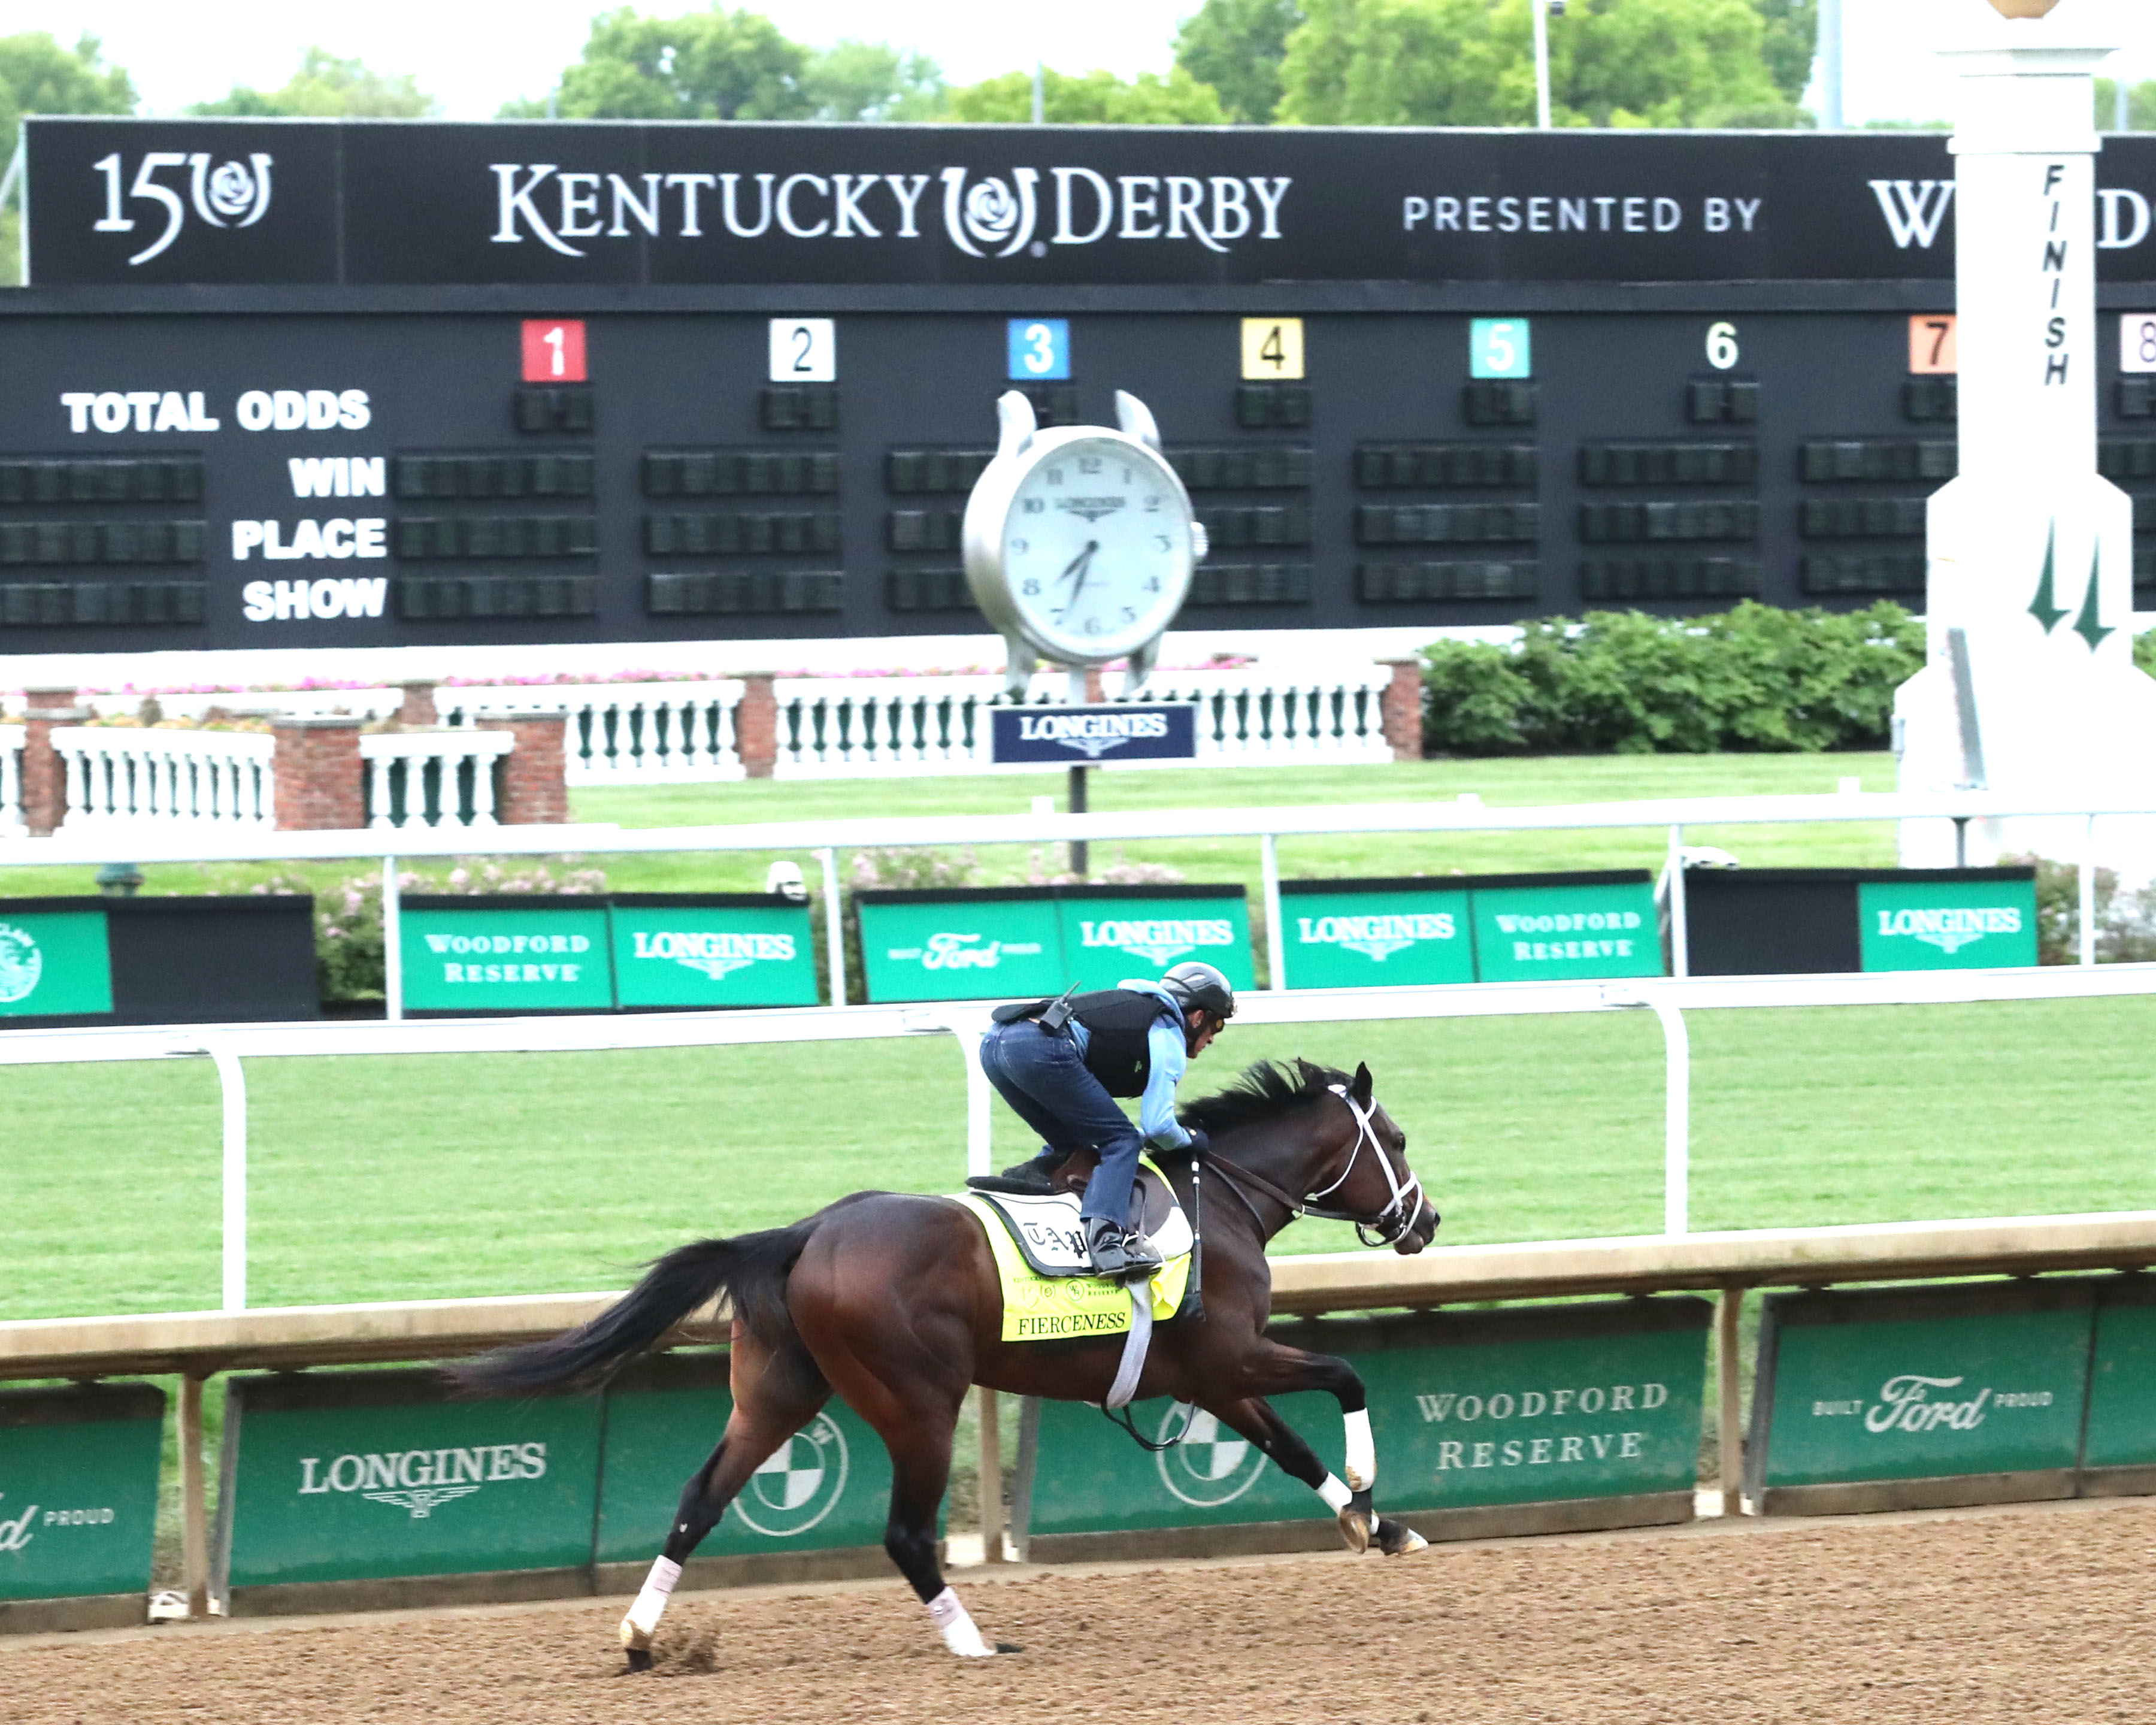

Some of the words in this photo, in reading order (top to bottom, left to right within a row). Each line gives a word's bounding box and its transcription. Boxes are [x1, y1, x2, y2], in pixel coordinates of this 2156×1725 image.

[490, 164, 929, 256] KENTUCKY
[1051, 167, 1291, 252] DERBY
[1405, 197, 1680, 231] PRESENTED
[1706, 198, 1760, 232] BY
[2044, 165, 2067, 384] FINISH
[543, 328, 565, 376] 1
[794, 327, 811, 371] 2
[1025, 324, 1053, 373] 3
[1261, 327, 1284, 368] 4
[1486, 324, 1515, 371] 5
[1706, 322, 1738, 369] 6
[1926, 321, 1949, 364] 7
[2142, 322, 2156, 362] 8
[61, 392, 219, 432] TOTAL
[237, 389, 370, 431] ODDS
[289, 457, 385, 497] WIN
[232, 518, 386, 560] PLACE
[243, 577, 387, 621] SHOW
[1021, 713, 1168, 740] LONGINES
[1081, 920, 1234, 946] LONGINES
[1298, 913, 1455, 943] LONGINES
[1496, 912, 1640, 932] WOODFORD
[1879, 907, 2021, 936] LONGINES
[425, 934, 589, 953] WOODFORD
[634, 932, 795, 961] LONGINES
[922, 933, 1001, 970] Ford
[1514, 940, 1632, 960] RESERVE
[445, 963, 579, 982] RESERVE
[1018, 1312, 1125, 1335] FIERCENESS
[1416, 1384, 1667, 1422] WOODFORD
[1866, 1375, 1991, 1433] Ford
[299, 1443, 546, 1494] LONGINES
[1436, 1433, 1642, 1470] RESERVE
[44, 1508, 114, 1526] PROUD
